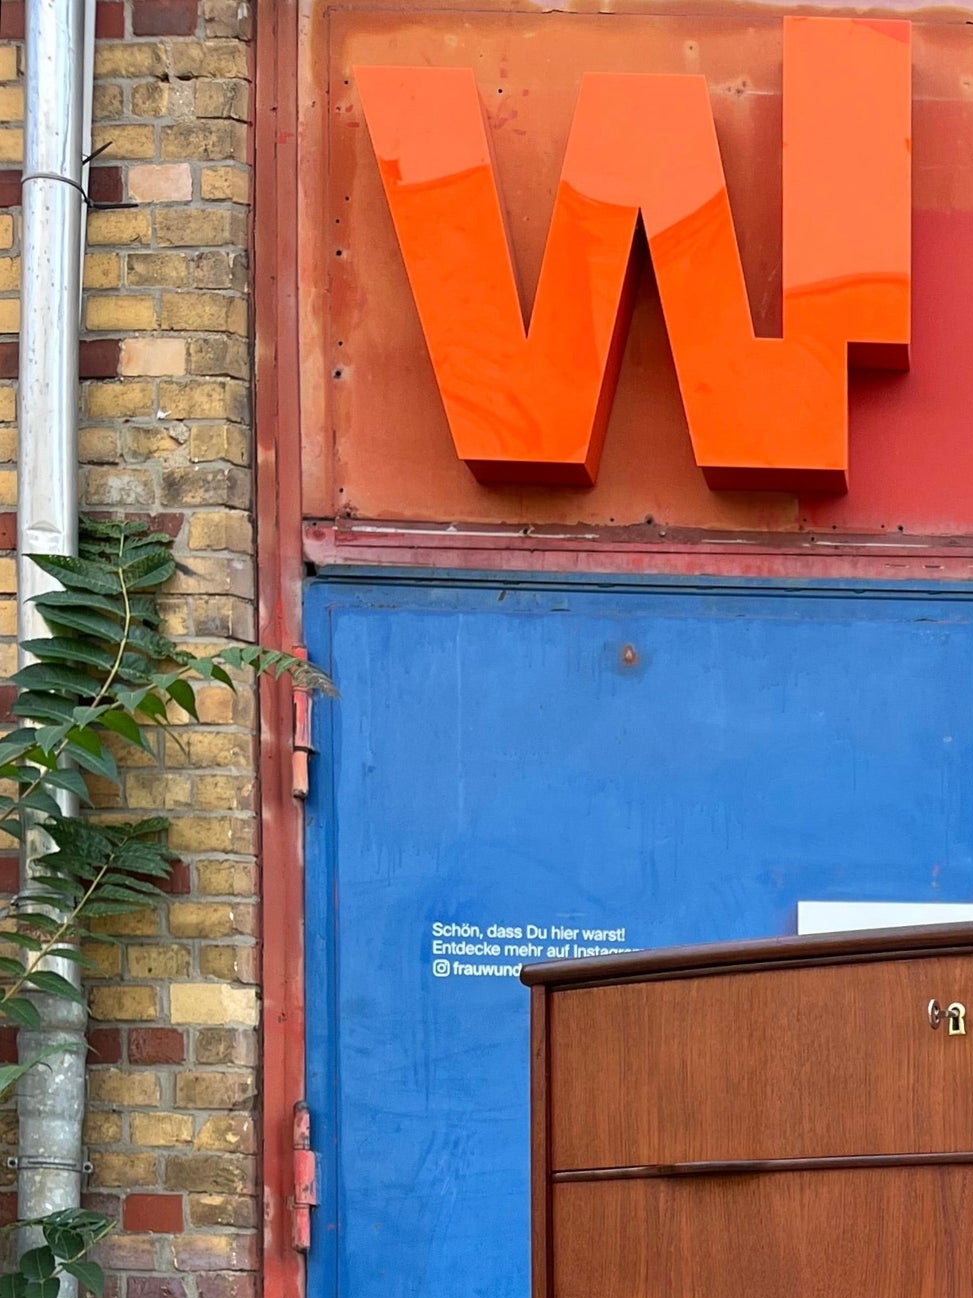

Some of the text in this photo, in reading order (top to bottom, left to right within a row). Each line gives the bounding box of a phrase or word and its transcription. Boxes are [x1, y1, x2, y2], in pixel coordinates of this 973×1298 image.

[432, 921, 625, 942] Schön, dass Du hier warst!
[432, 940, 501, 956] Entdecke
[504, 942, 543, 957] mehr
[546, 944, 570, 959] auf
